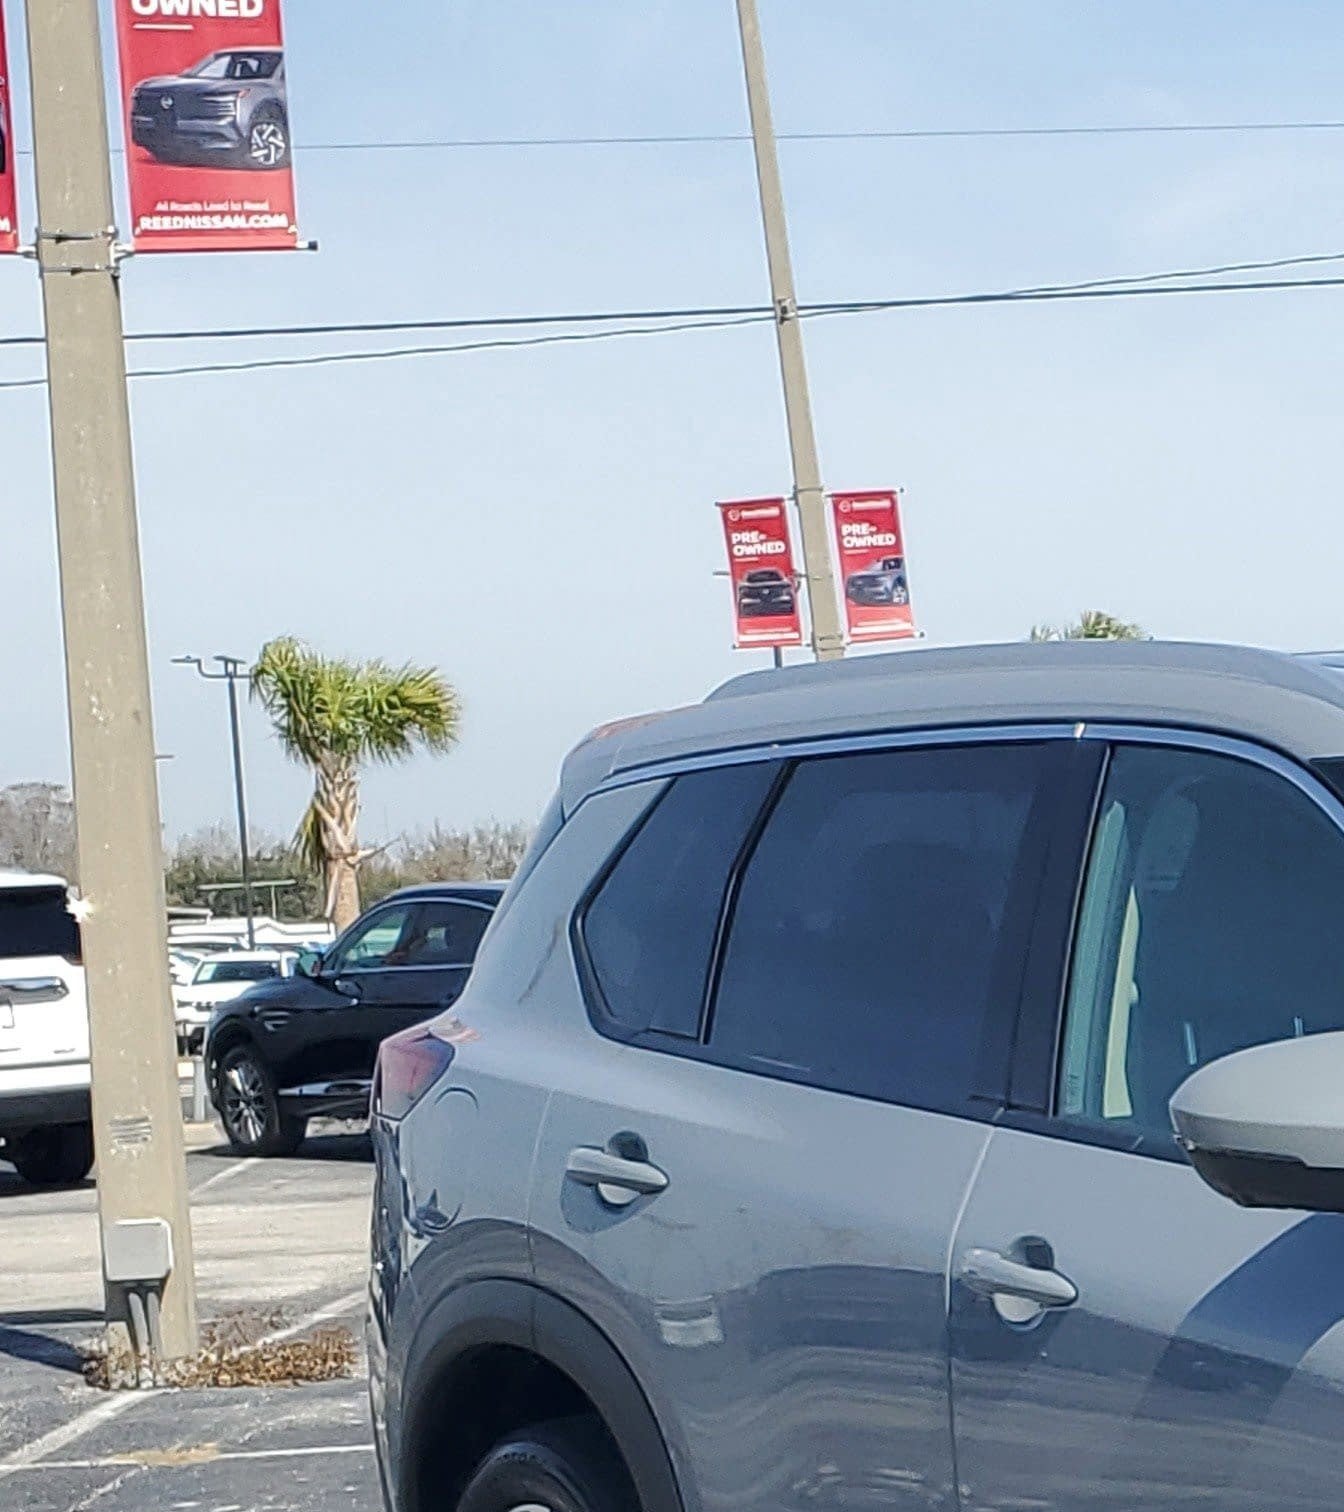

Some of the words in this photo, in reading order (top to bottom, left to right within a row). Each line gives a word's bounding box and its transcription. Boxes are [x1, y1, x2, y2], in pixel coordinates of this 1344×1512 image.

[131, 0, 264, 17] OWNED
[139, 214, 289, 230] REEDNISSAN.COM
[731, 530, 767, 544] PRE-
[841, 523, 877, 537] PRE-
[733, 540, 786, 556] OWNED
[843, 533, 896, 548] OWNED
